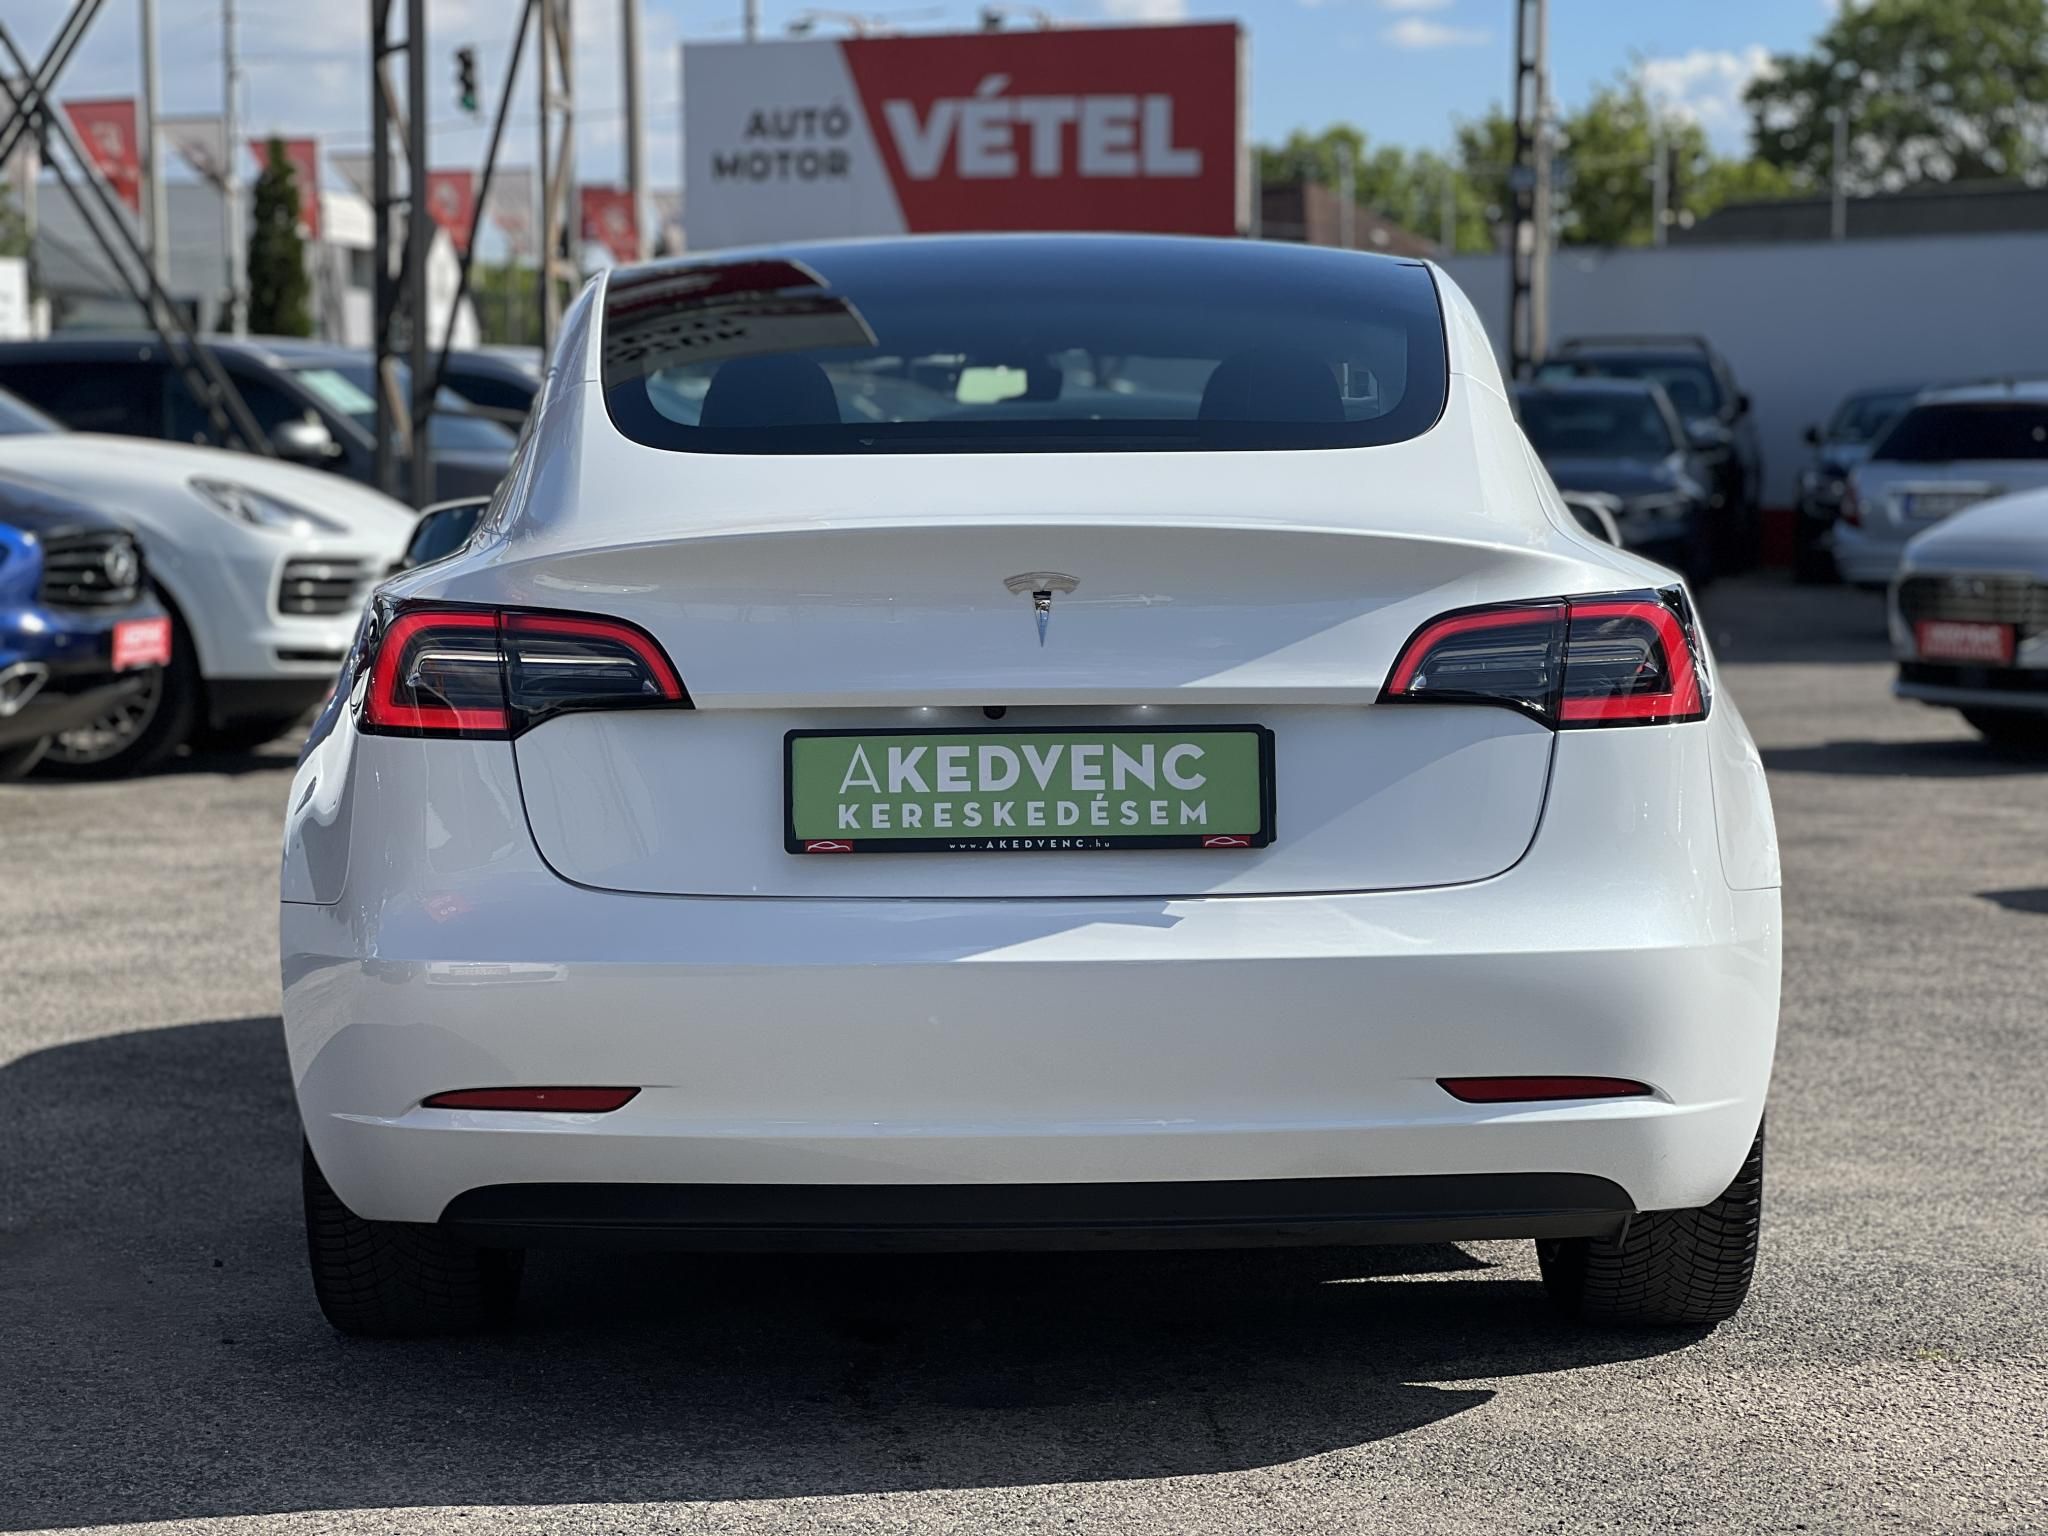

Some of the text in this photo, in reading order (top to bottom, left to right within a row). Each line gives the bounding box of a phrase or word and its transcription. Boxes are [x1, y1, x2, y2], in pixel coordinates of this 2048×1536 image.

[743, 97, 852, 141] AUTÓ
[882, 73, 1202, 179] VÉTEL
[711, 148, 852, 183] MOTOR
[838, 743, 1207, 794] AKEDVENC
[838, 793, 1208, 829] KERESKEDÉSEM
[949, 838, 1111, 849] www.AKEDVENC.hu
